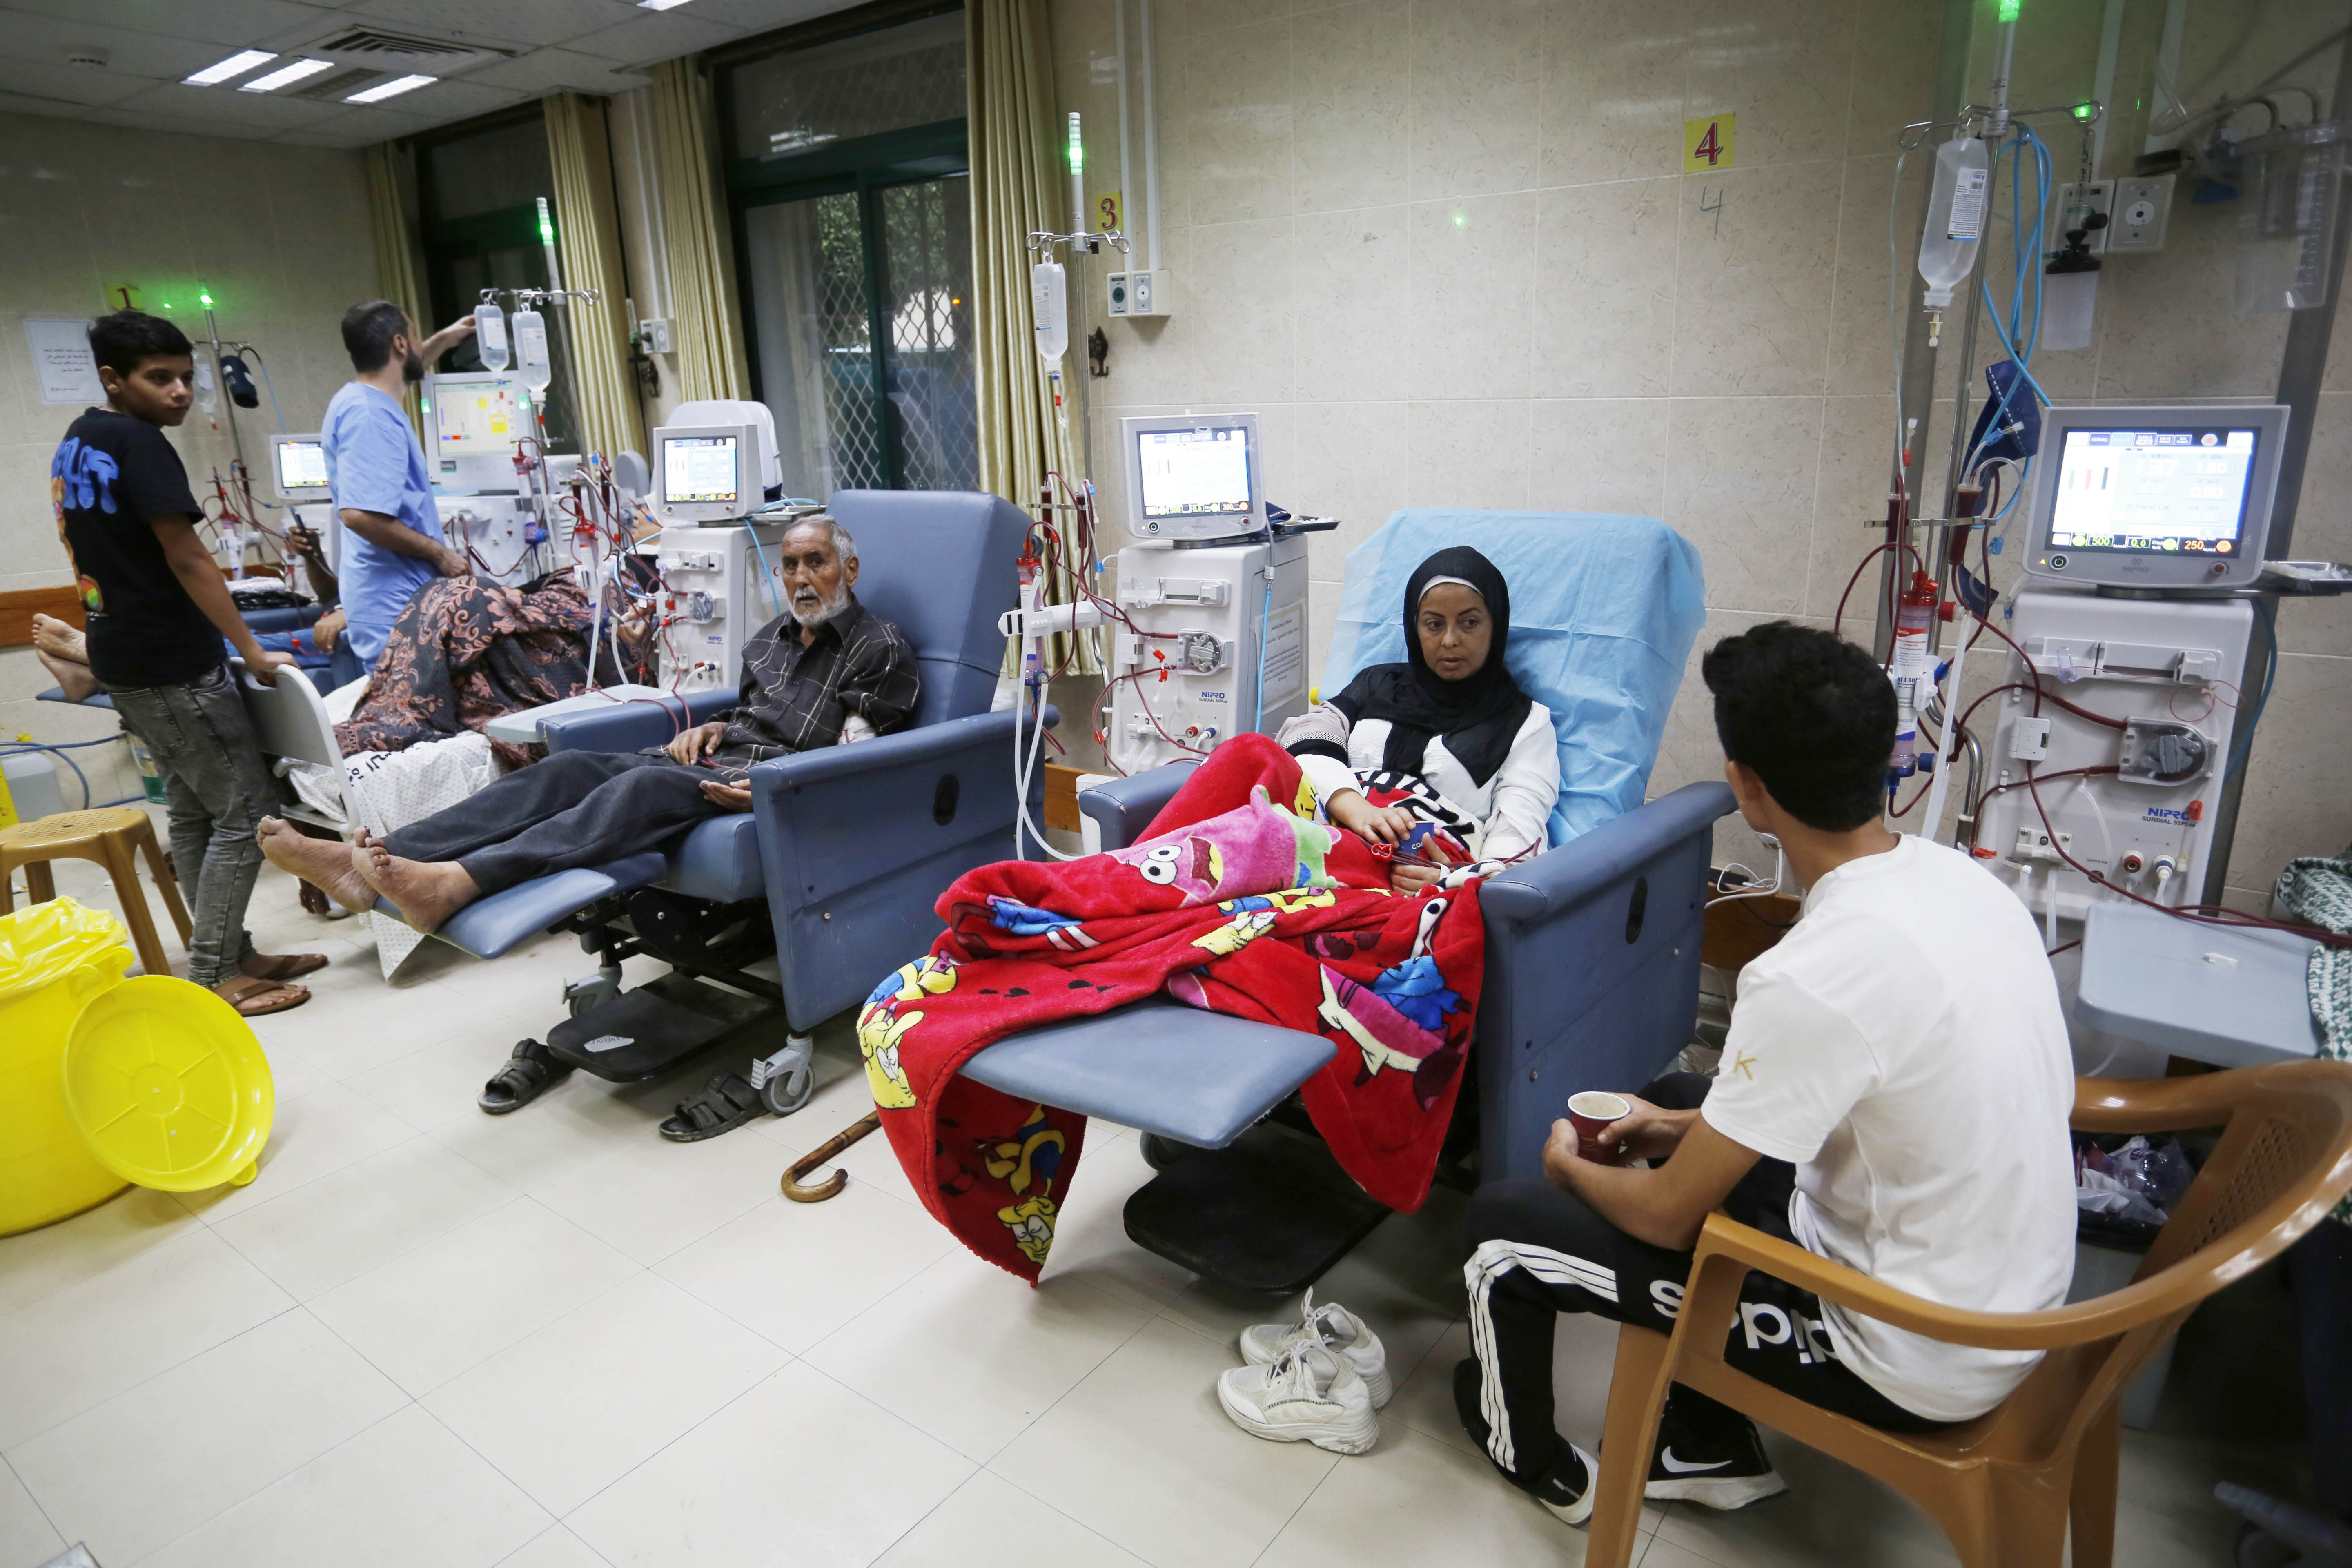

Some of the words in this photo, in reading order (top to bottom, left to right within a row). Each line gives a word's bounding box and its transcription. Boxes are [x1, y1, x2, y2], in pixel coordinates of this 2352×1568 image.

[1693, 120, 1724, 165] 4
[1100, 198, 1117, 230] 3
[1700, 185, 1723, 236] 4
[116, 287, 137, 310] 1
[2091, 537, 2110, 546] 500
[2130, 538, 2147, 548] 0.0
[2184, 540, 2204, 550] 250
[2142, 815, 2172, 825] SURDIAL
[1733, 1050, 1758, 1081] K
